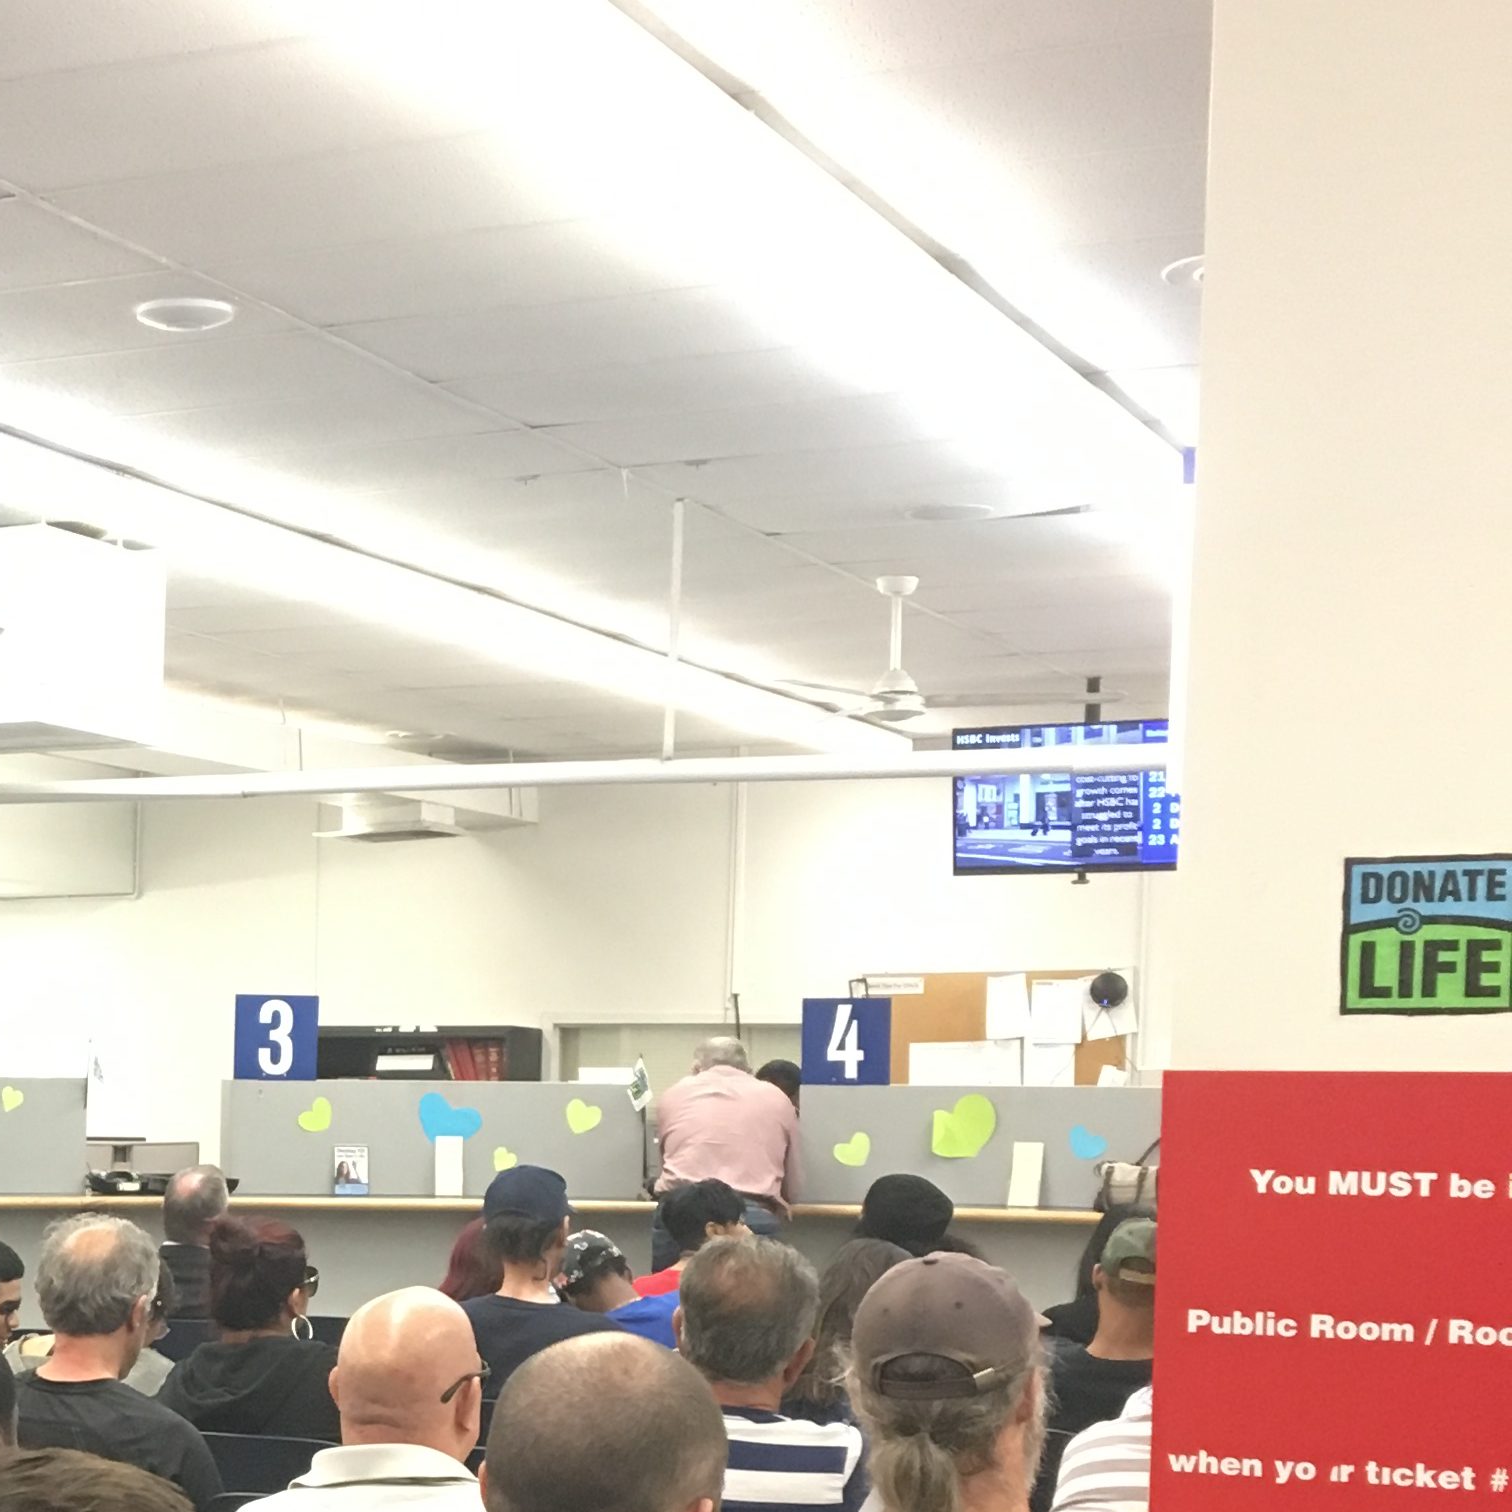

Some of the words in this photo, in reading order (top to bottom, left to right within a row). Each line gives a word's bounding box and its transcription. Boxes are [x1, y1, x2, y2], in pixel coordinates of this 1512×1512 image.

[956, 733, 983, 745] HSBC
[985, 732, 1020, 744] Invests
[1148, 770, 1166, 782] 21
[1148, 786, 1166, 798] 22
[1152, 801, 1162, 814] 2
[1152, 817, 1162, 830] 2
[1148, 833, 1166, 846] 23
[1360, 868, 1507, 904] DONATE
[1358, 938, 1503, 999] LIFE
[257, 999, 294, 1076] 3
[826, 1003, 865, 1079] 4
[1249, 1168, 1316, 1195] You
[1328, 1170, 1438, 1198] MUST
[1449, 1172, 1496, 1199] be
[1187, 1308, 1298, 1337] Public
[1309, 1313, 1415, 1343] Room
[1424, 1318, 1439, 1346] /
[1168, 1450, 1263, 1478] when
[1365, 1460, 1477, 1491] ticket
[1490, 1467, 1510, 1493] #
